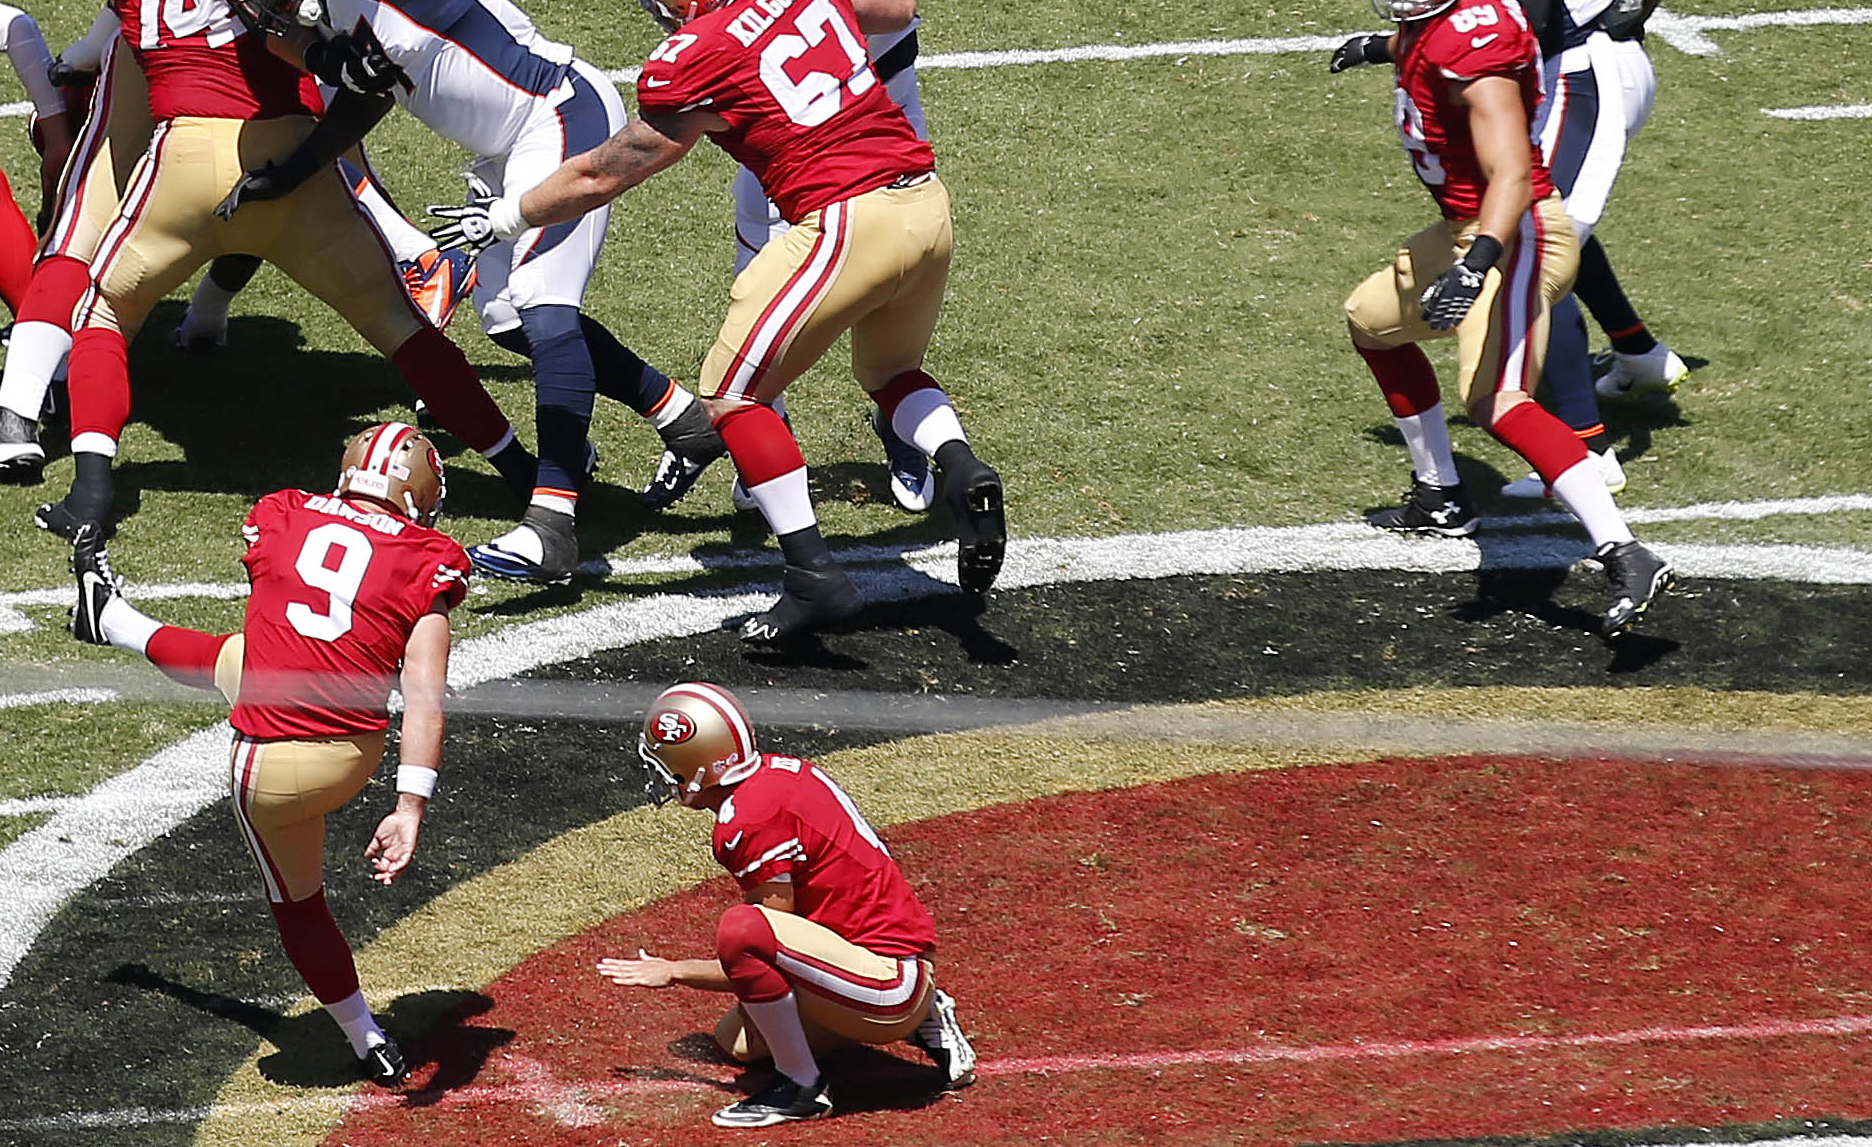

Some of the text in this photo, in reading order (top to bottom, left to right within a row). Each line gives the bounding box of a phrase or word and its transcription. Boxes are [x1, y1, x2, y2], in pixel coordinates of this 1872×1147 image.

[303, 495, 405, 536] DAWSON
[285, 522, 374, 643] 9
[658, 712, 688, 742] SF
